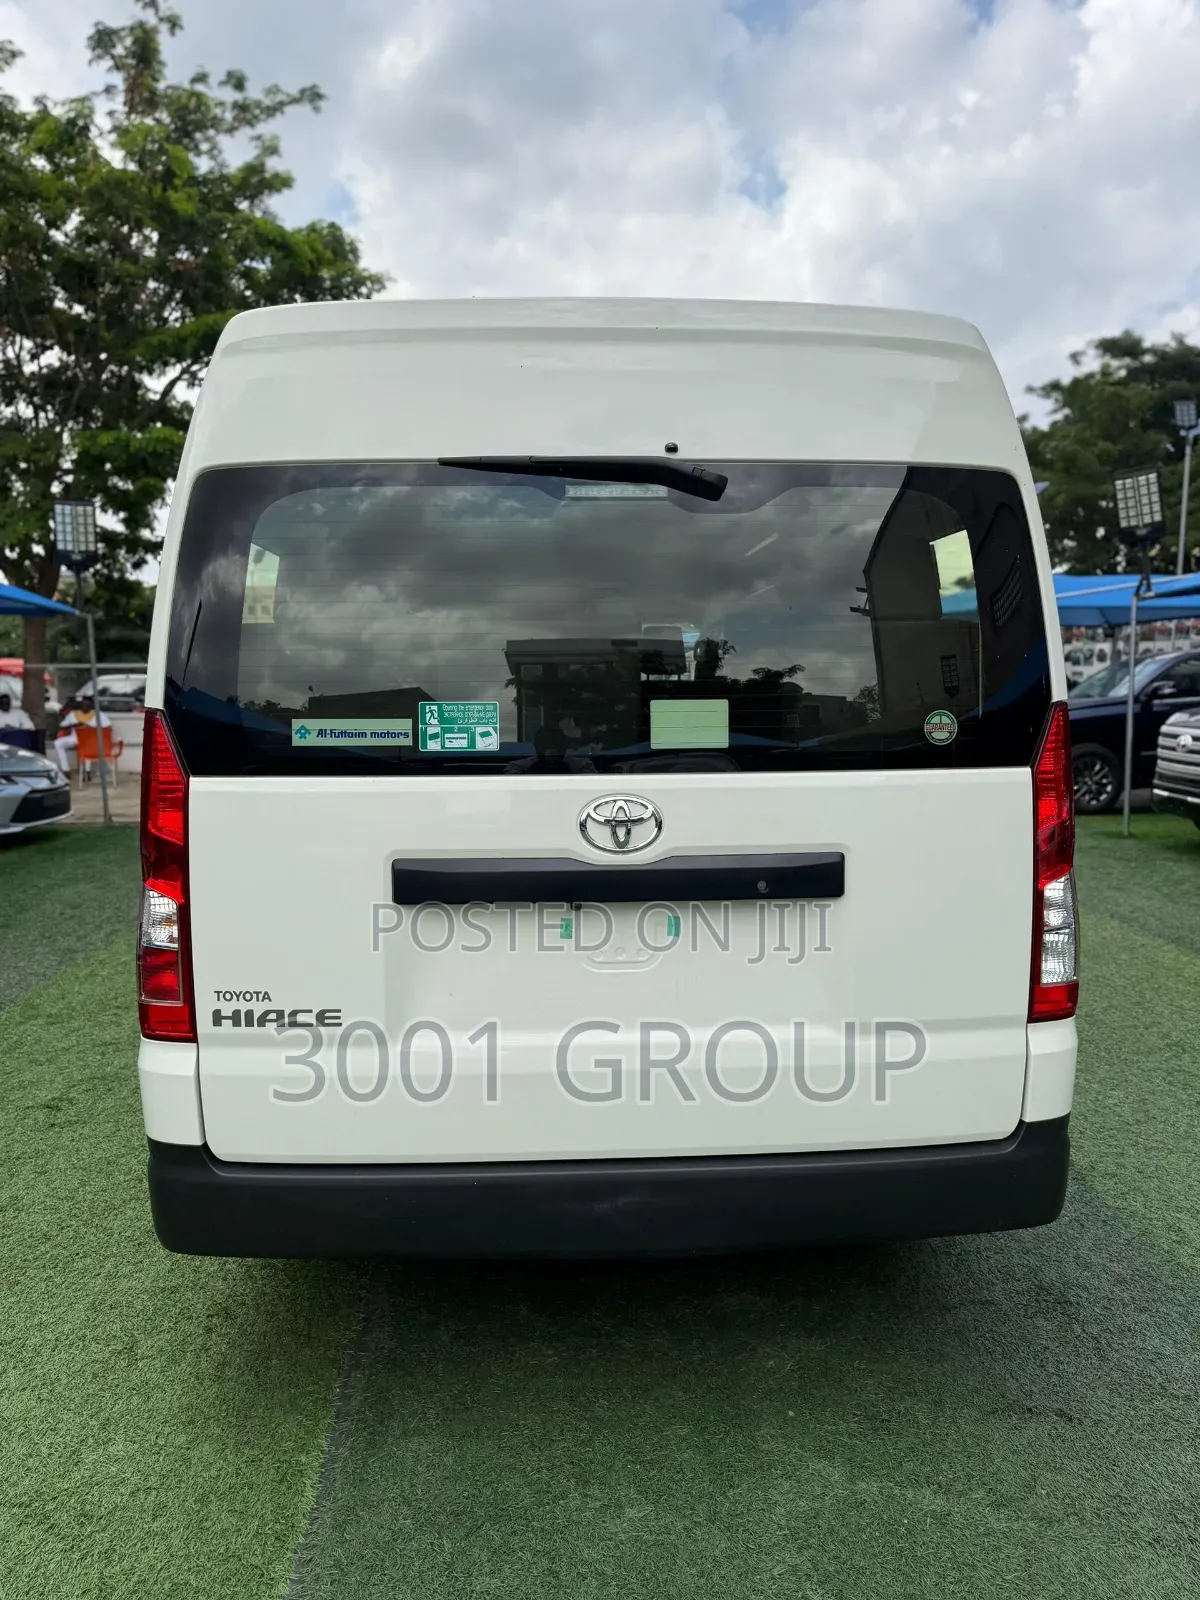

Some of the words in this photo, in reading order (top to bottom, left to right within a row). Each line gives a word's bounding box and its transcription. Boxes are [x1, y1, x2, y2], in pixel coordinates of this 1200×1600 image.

[370, 730, 409, 739] motors
[214, 990, 272, 1002] TOYOTA
[212, 1008, 342, 1028] HIACE
